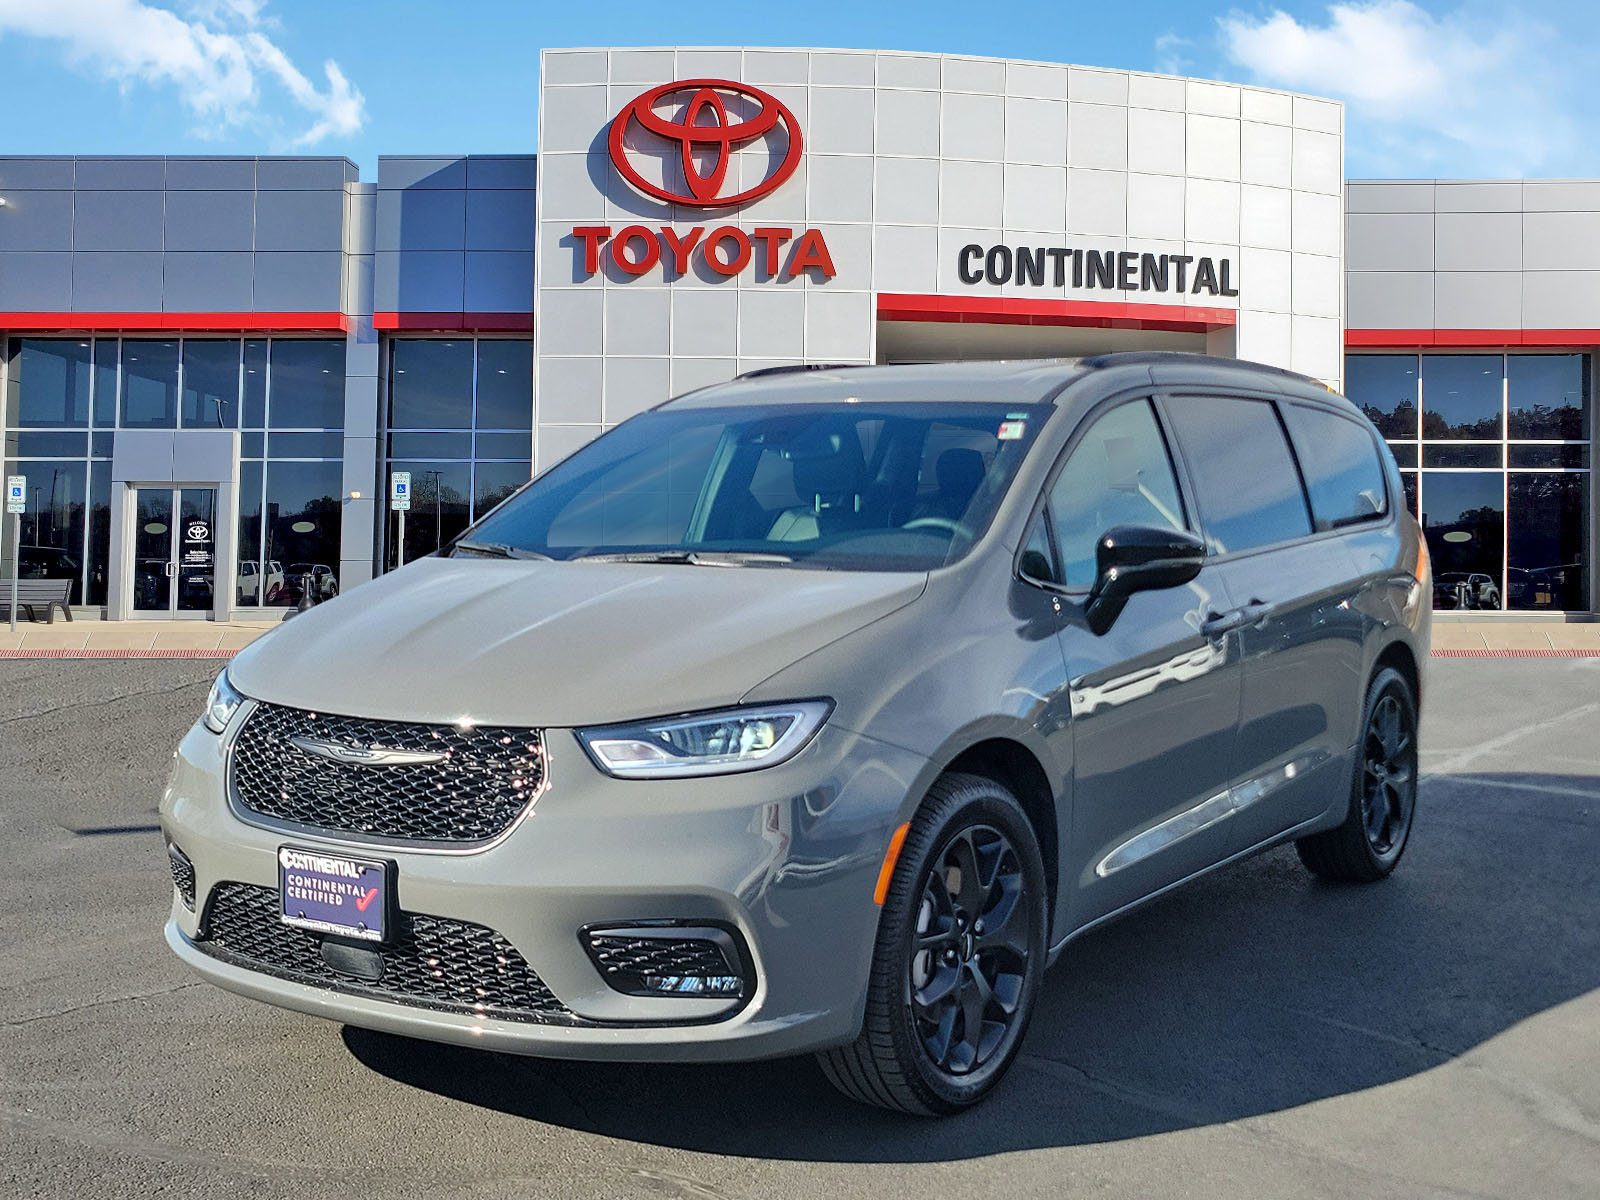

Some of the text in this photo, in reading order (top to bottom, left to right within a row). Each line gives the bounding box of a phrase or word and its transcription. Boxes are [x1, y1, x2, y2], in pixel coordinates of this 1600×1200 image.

[573, 225, 837, 277] TOYOTA
[958, 244, 1239, 297] CONTINENTAL
[287, 874, 366, 898] CONTINENTAL
[287, 886, 343, 906] CERTIFIED
